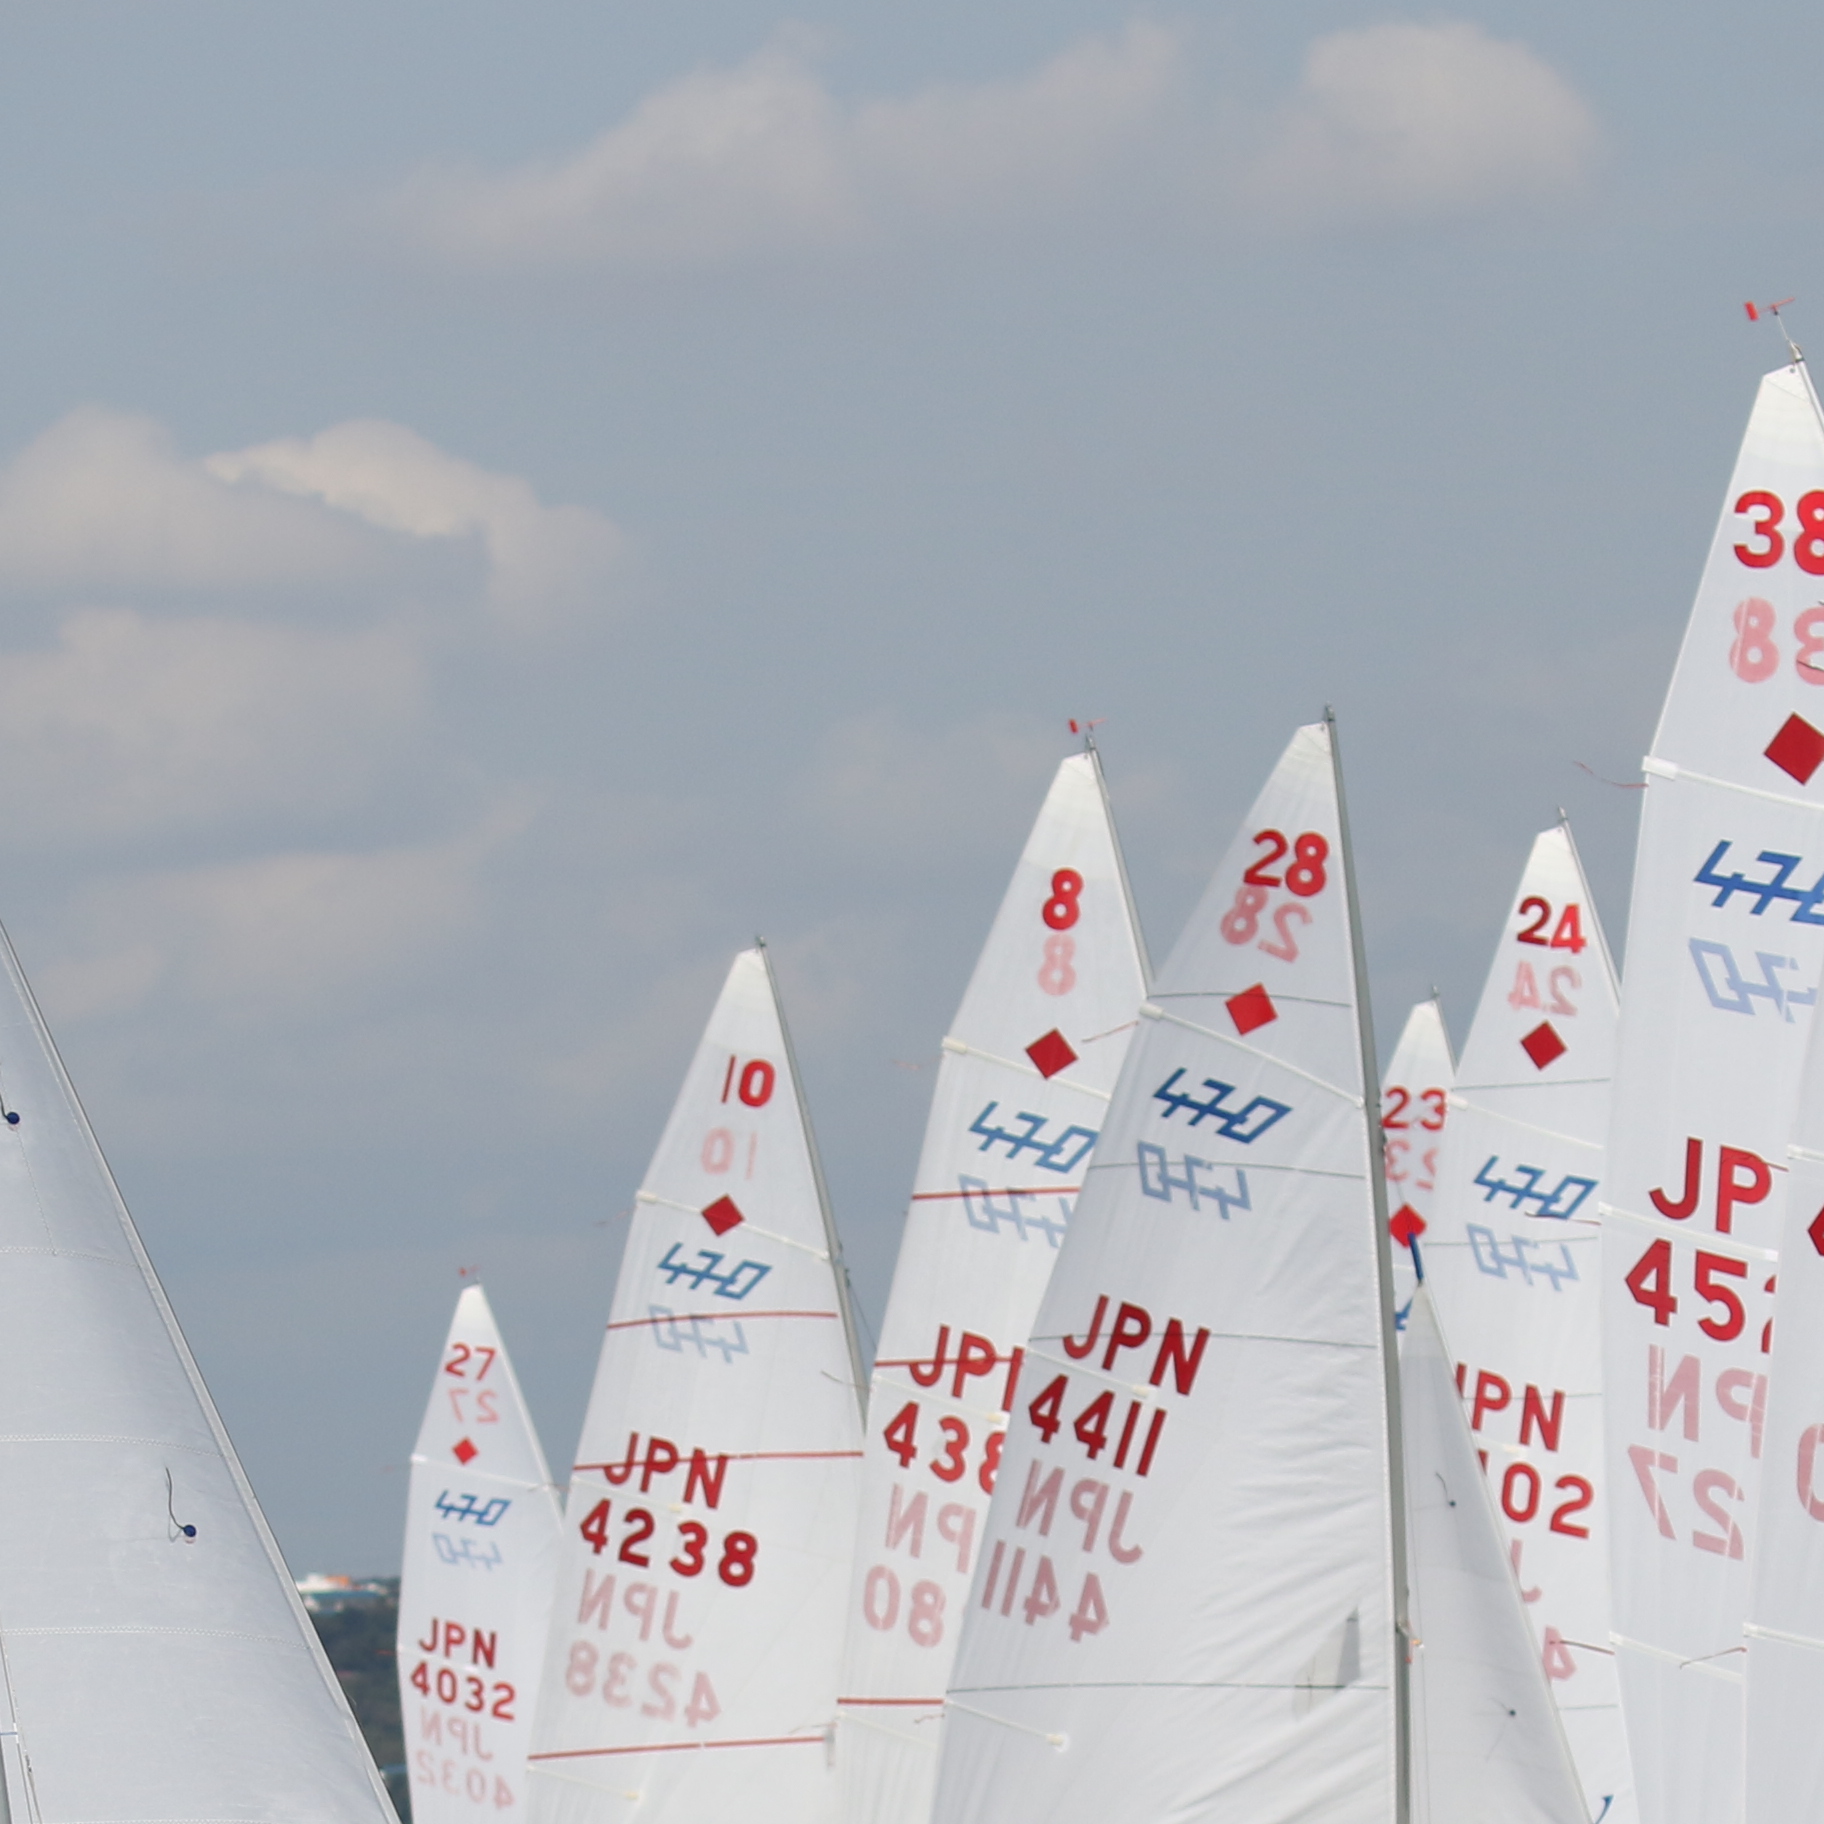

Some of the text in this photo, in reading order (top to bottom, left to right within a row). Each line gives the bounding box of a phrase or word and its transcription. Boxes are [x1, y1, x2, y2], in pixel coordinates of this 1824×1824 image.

[1243, 829, 1328, 897] 28
[1041, 867, 1083, 931] 8
[1517, 895, 1586, 955] 24
[721, 1054, 776, 1108] 10
[1153, 1067, 1292, 1144] 470
[1381, 1086, 1446, 1131] 23
[968, 1101, 1100, 1174] 470
[1473, 1155, 1599, 1222] 470
[1649, 1137, 1773, 1236] JP
[656, 1242, 772, 1301] 470
[445, 1344, 496, 1381] 27
[1062, 1294, 1211, 1397] JPN
[1028, 1372, 1167, 1476] 4411
[603, 1432, 729, 1511] JPN
[1478, 1448, 1594, 1539] 02
[435, 1489, 512, 1527] 470
[580, 1499, 758, 1589] 4238
[418, 1617, 497, 1669] JPN
[409, 1661, 516, 1722] 4032
